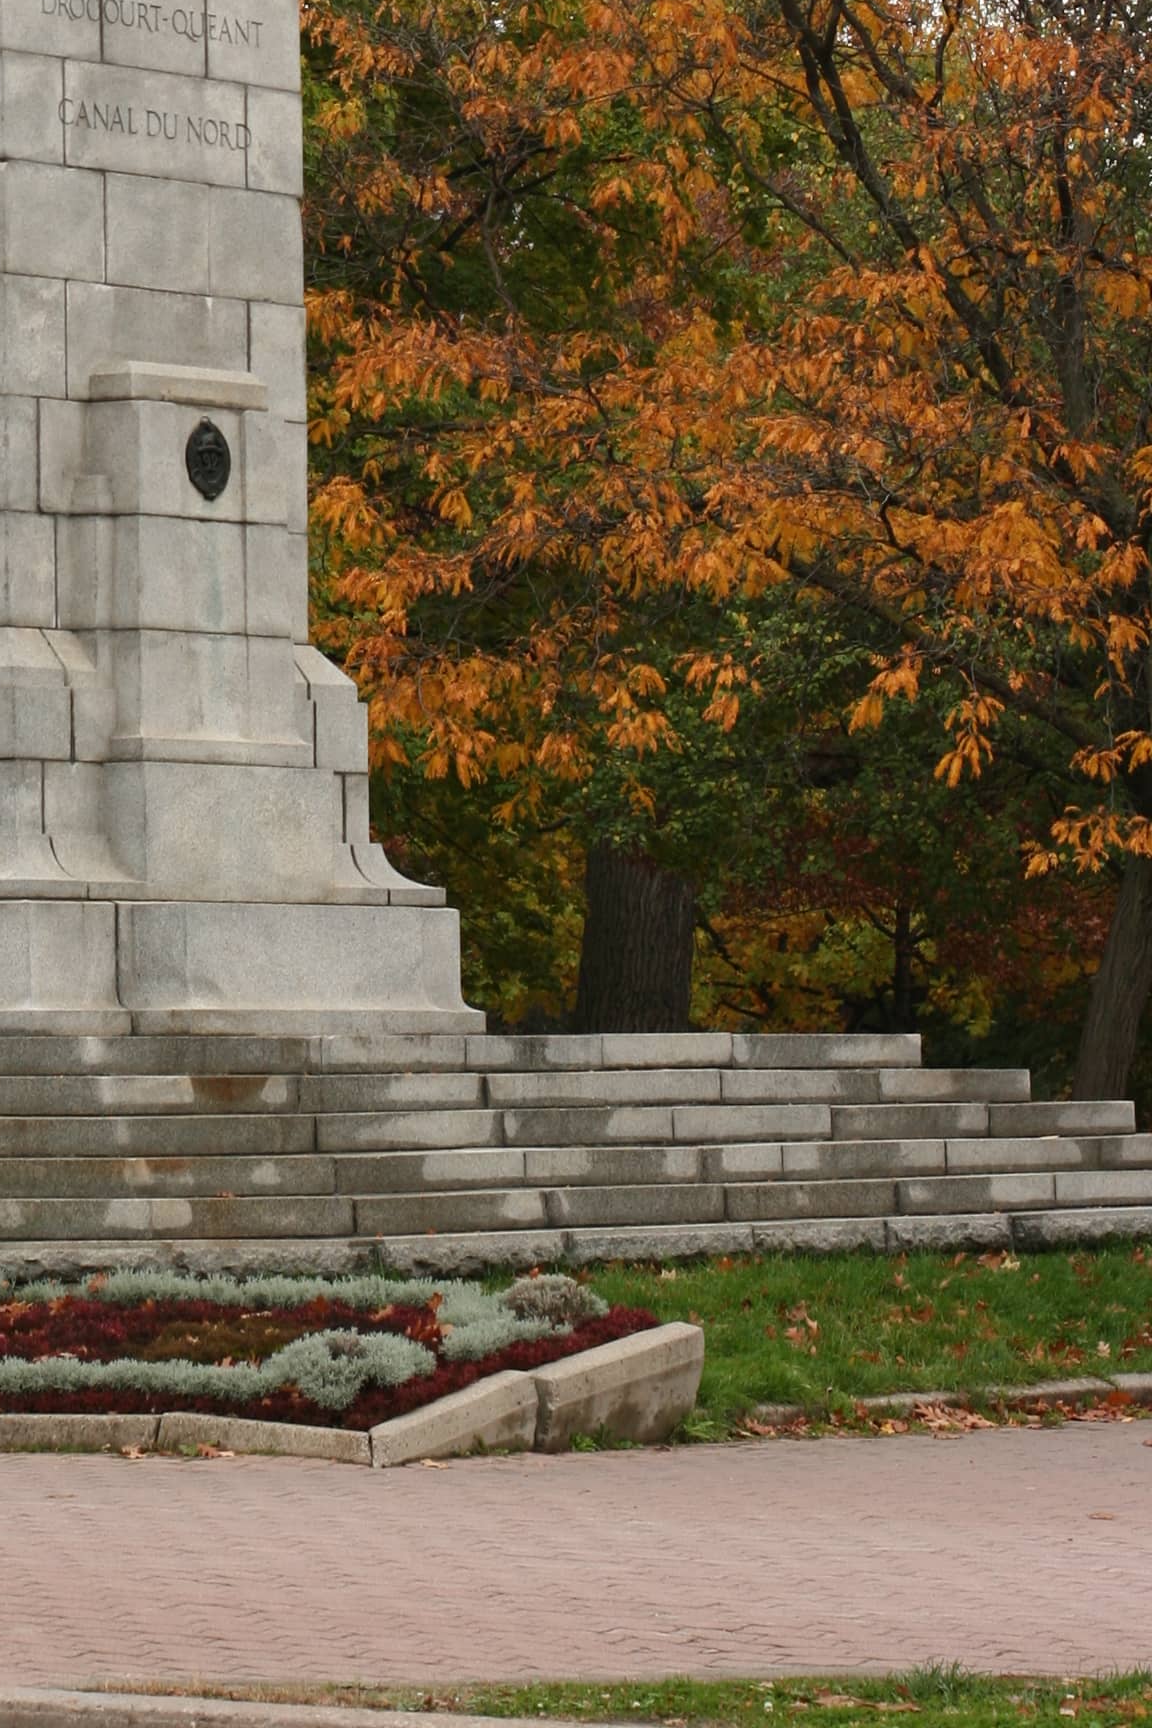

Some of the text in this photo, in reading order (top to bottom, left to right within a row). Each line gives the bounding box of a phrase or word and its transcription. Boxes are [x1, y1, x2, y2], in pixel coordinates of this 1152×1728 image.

[57, 97, 252, 151] CANAL DU NORD
